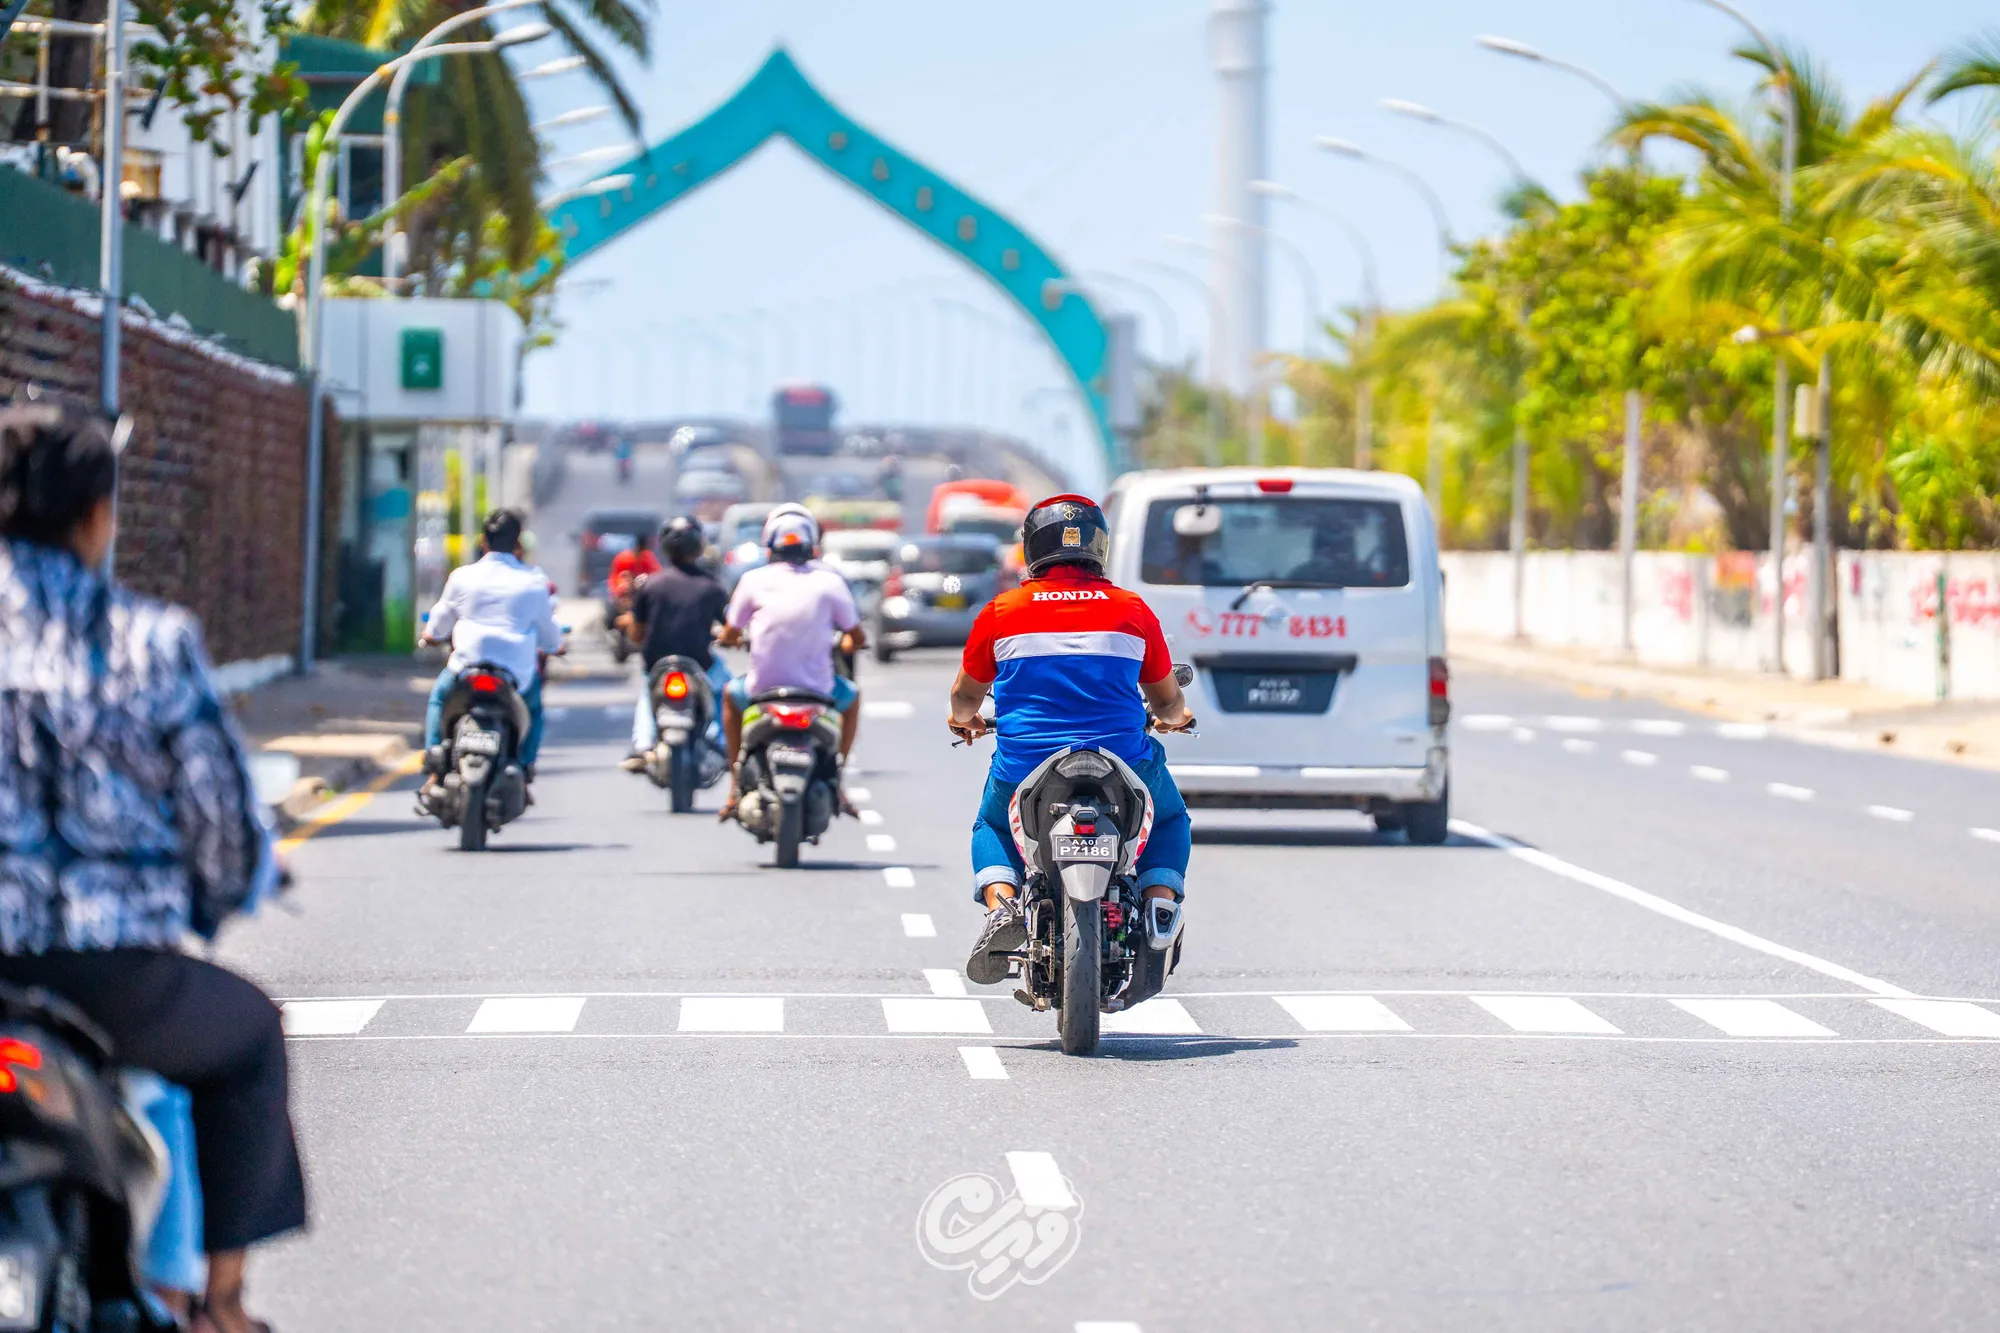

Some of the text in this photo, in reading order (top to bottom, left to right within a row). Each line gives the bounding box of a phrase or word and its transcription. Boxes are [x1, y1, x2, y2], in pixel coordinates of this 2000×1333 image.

[1032, 590, 1109, 602] HONDA
[1219, 612, 1264, 637] 777
[1060, 846, 1110, 857] P7186
